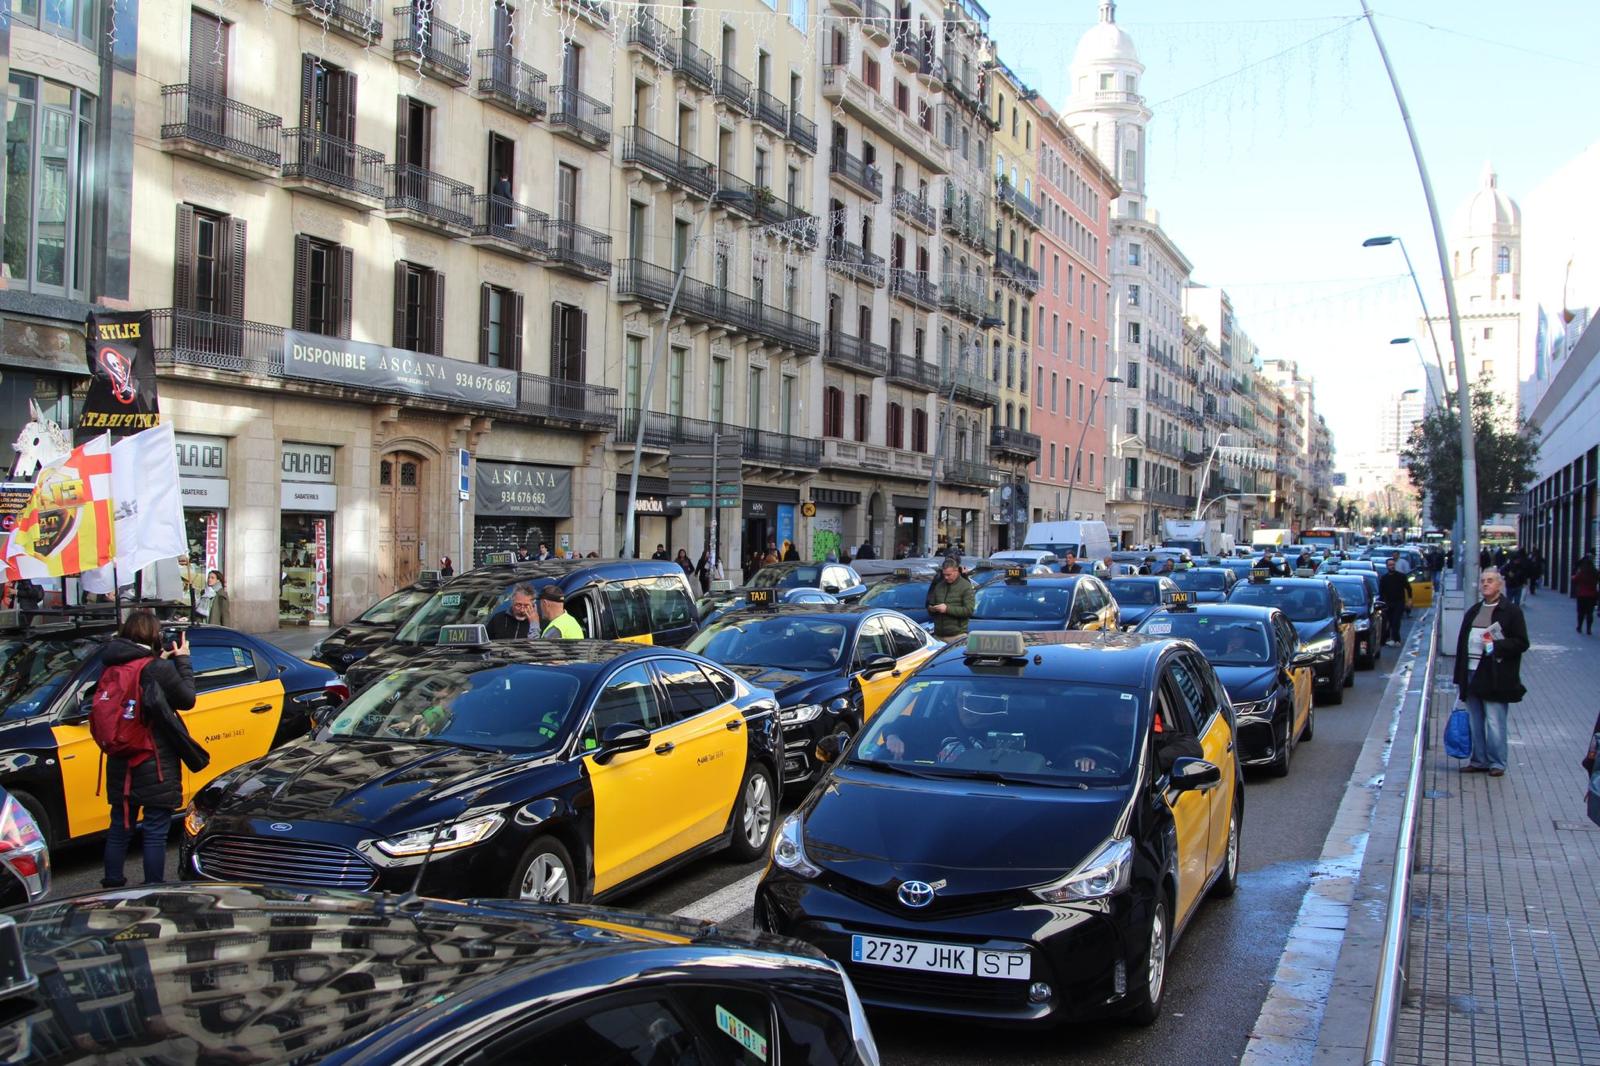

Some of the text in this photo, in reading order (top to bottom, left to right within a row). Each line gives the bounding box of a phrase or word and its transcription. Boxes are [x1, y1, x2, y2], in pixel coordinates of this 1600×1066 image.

[293, 344, 511, 395] DISPONIBLE ASCANA 934 676 662
[202, 446, 223, 468] DEI
[313, 454, 332, 475] DEI
[491, 468, 555, 487] ASCANA
[501, 491, 546, 504] 934 676 662
[207, 511, 218, 569] REBA
[316, 520, 326, 613] REBAJAS
[750, 591, 767, 601] TAXI
[1171, 593, 1188, 602] TAXI
[449, 629, 467, 642] TAXI
[981, 636, 1004, 650] TAXI
[866, 940, 965, 970] 2737 JHK
